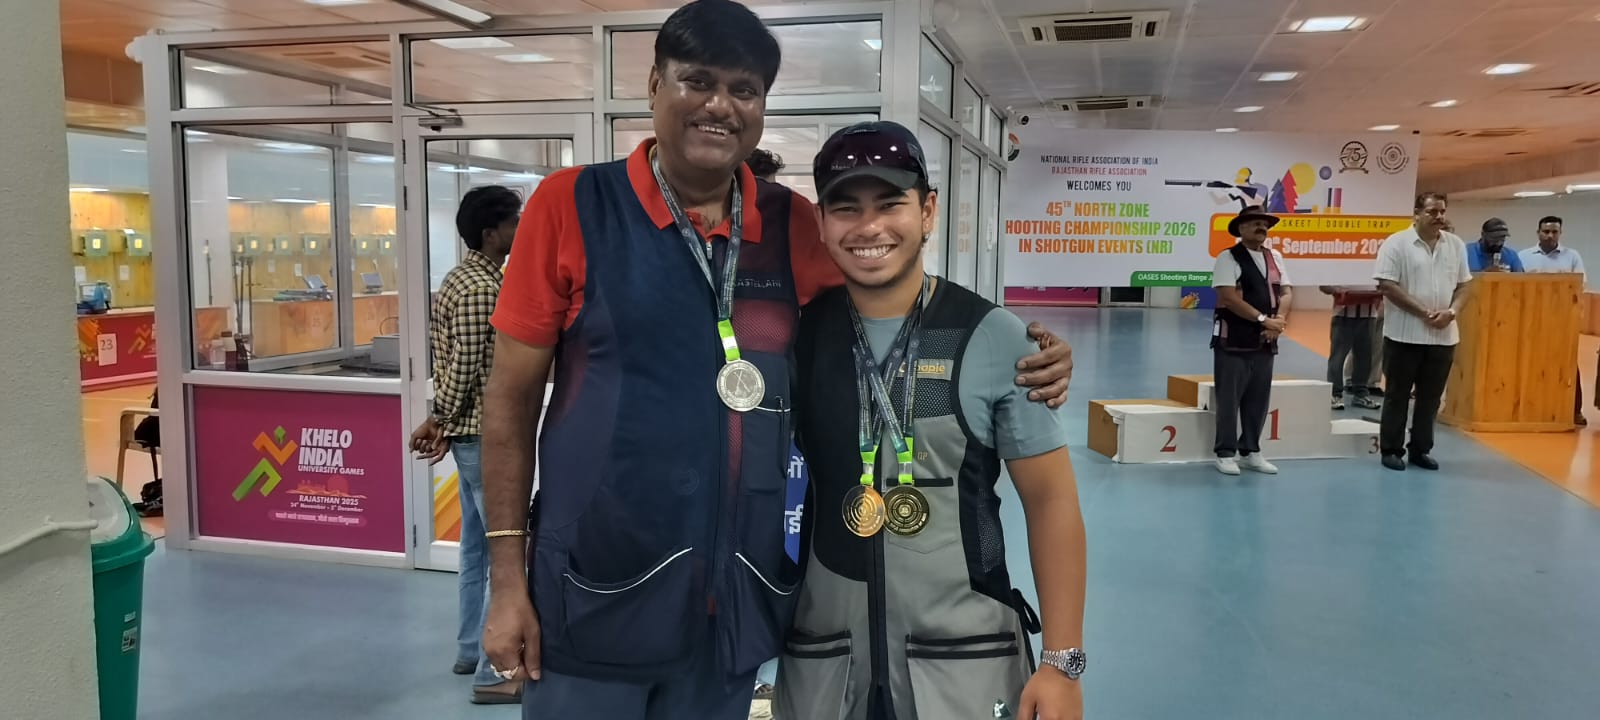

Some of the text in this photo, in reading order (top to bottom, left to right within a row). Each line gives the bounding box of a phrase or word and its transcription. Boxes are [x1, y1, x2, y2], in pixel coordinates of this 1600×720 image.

[1041, 155, 1158, 165] NATIONAL RIFLE ASSOCIATION OF INDIA
[1052, 166, 1147, 175] RAJASTHAN RIFLE ASSOCIATION
[1067, 180, 1131, 191] WELCOMES YOU
[1074, 203, 1116, 217] NORTH
[1119, 203, 1149, 218] ZONE
[1005, 220, 1195, 236] HOOTING CHAMPIONSHIP 2026
[1283, 219, 1391, 228] SKEET DOUBLE TRAP
[1019, 239, 1172, 254] IN SHOTGUN EVENTS (NR)
[1283, 237, 1357, 255] September
[100, 339, 113, 351] 23
[1267, 409, 1281, 440] 1
[301, 428, 352, 448] KHELO
[1160, 425, 1177, 452] 2
[1368, 436, 1379, 454] 3
[299, 447, 343, 467] INDIA
[298, 465, 364, 475] UNIVERSITY GAMES
[299, 495, 339, 504] RAJASTHAN
